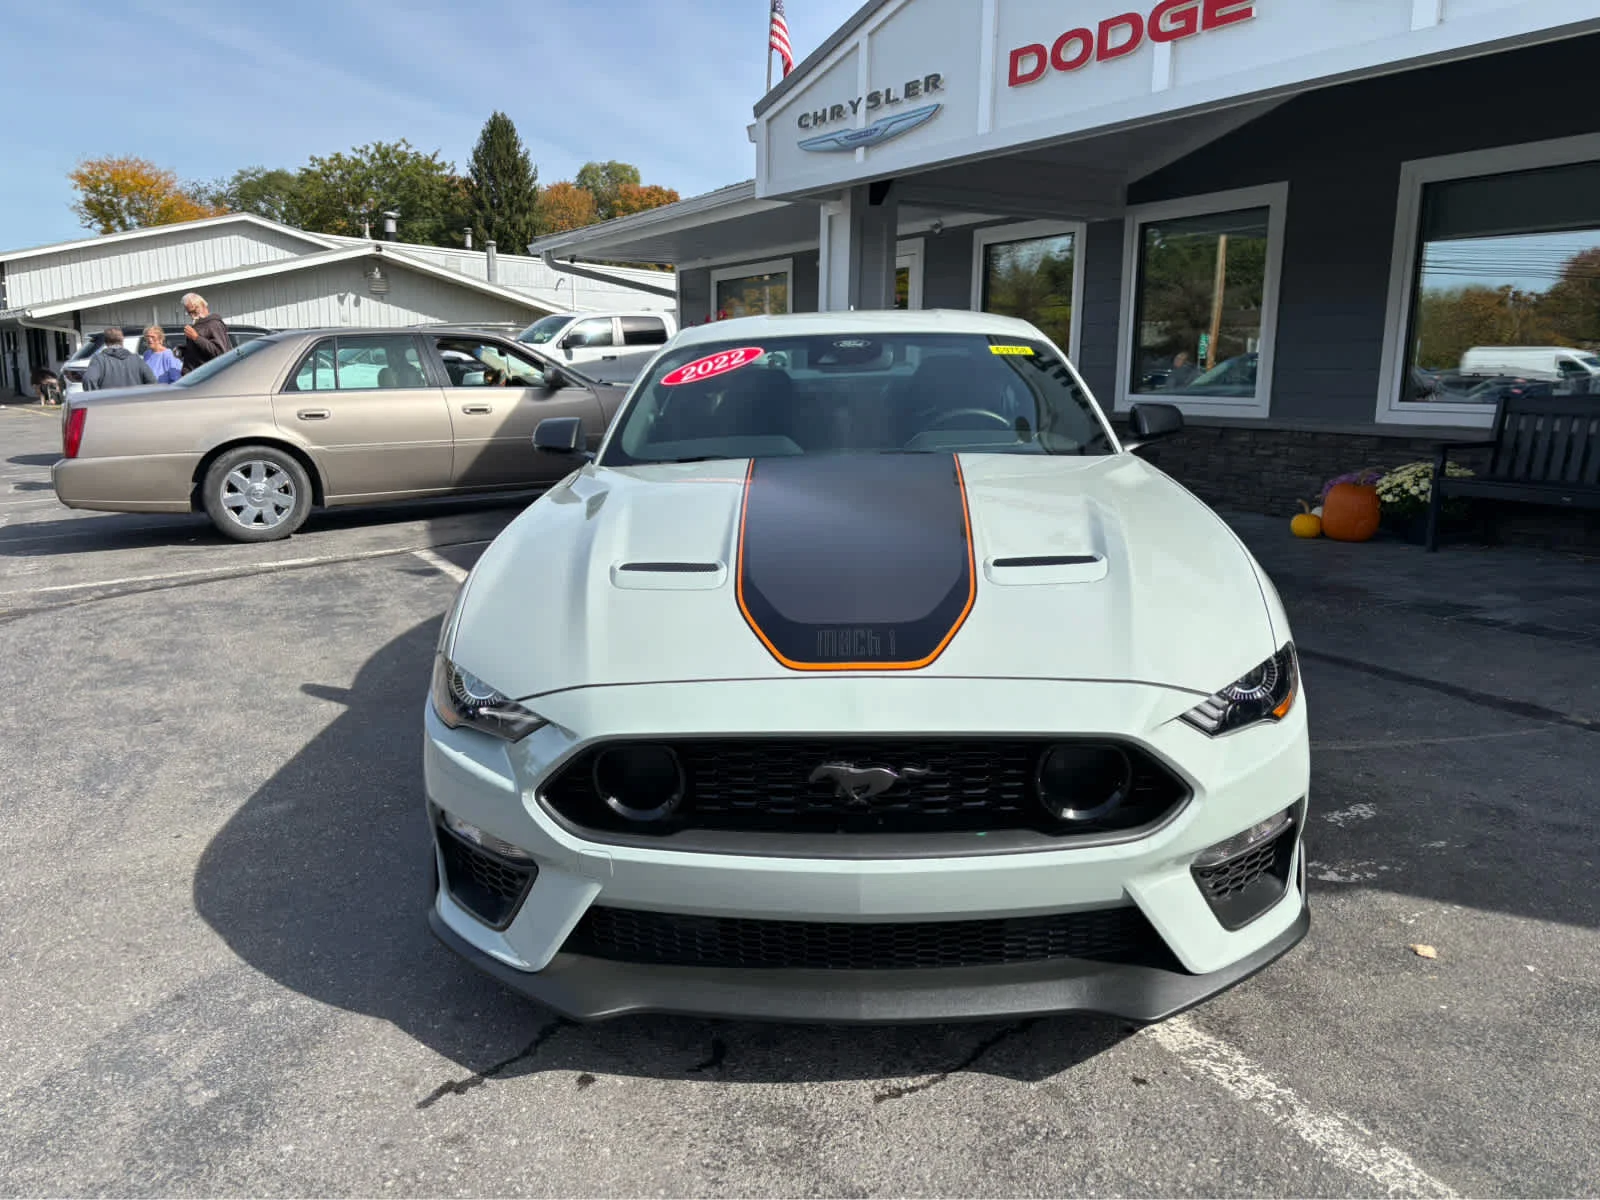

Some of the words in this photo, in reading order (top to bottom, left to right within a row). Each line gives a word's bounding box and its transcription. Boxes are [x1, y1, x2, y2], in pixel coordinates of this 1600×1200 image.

[1008, 0, 1253, 87] DODGE
[798, 73, 943, 128] CHRYSLER
[681, 350, 745, 381] 2022
